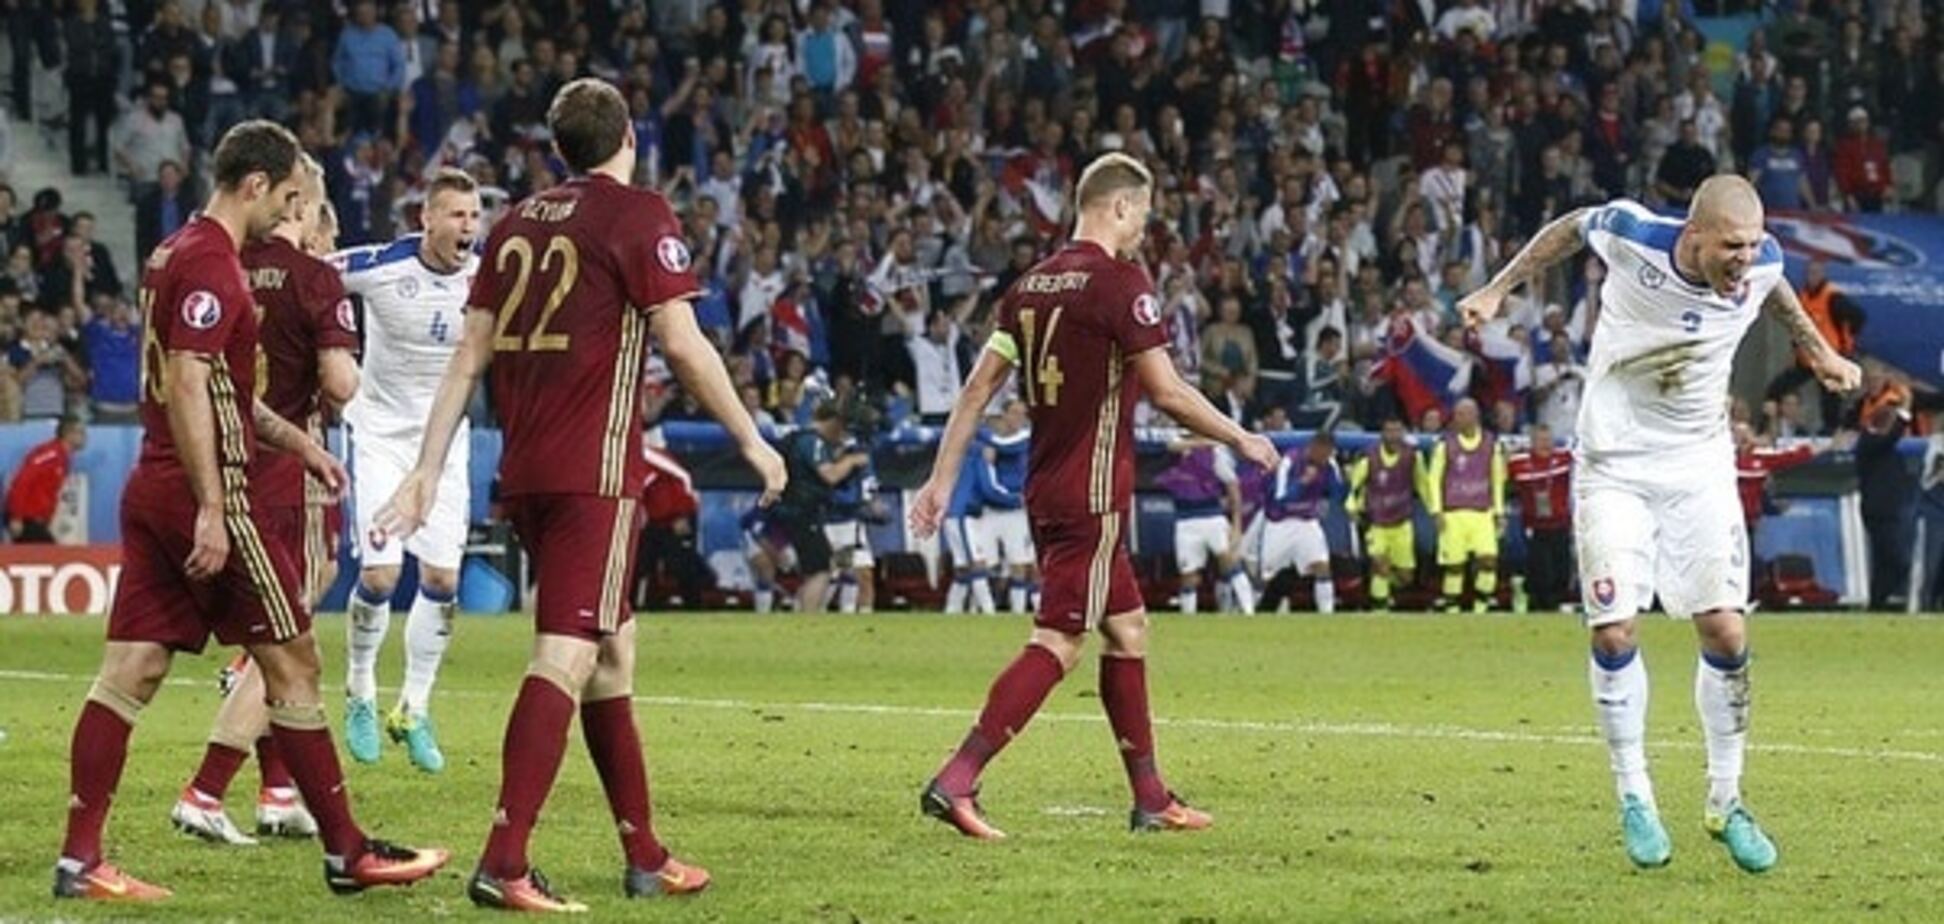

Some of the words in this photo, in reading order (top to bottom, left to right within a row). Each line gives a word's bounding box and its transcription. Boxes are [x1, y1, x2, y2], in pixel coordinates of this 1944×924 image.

[429, 310, 449, 342] 4
[494, 235, 579, 351] 22
[1018, 305, 1064, 407] 14
[1730, 523, 1745, 569] 3
